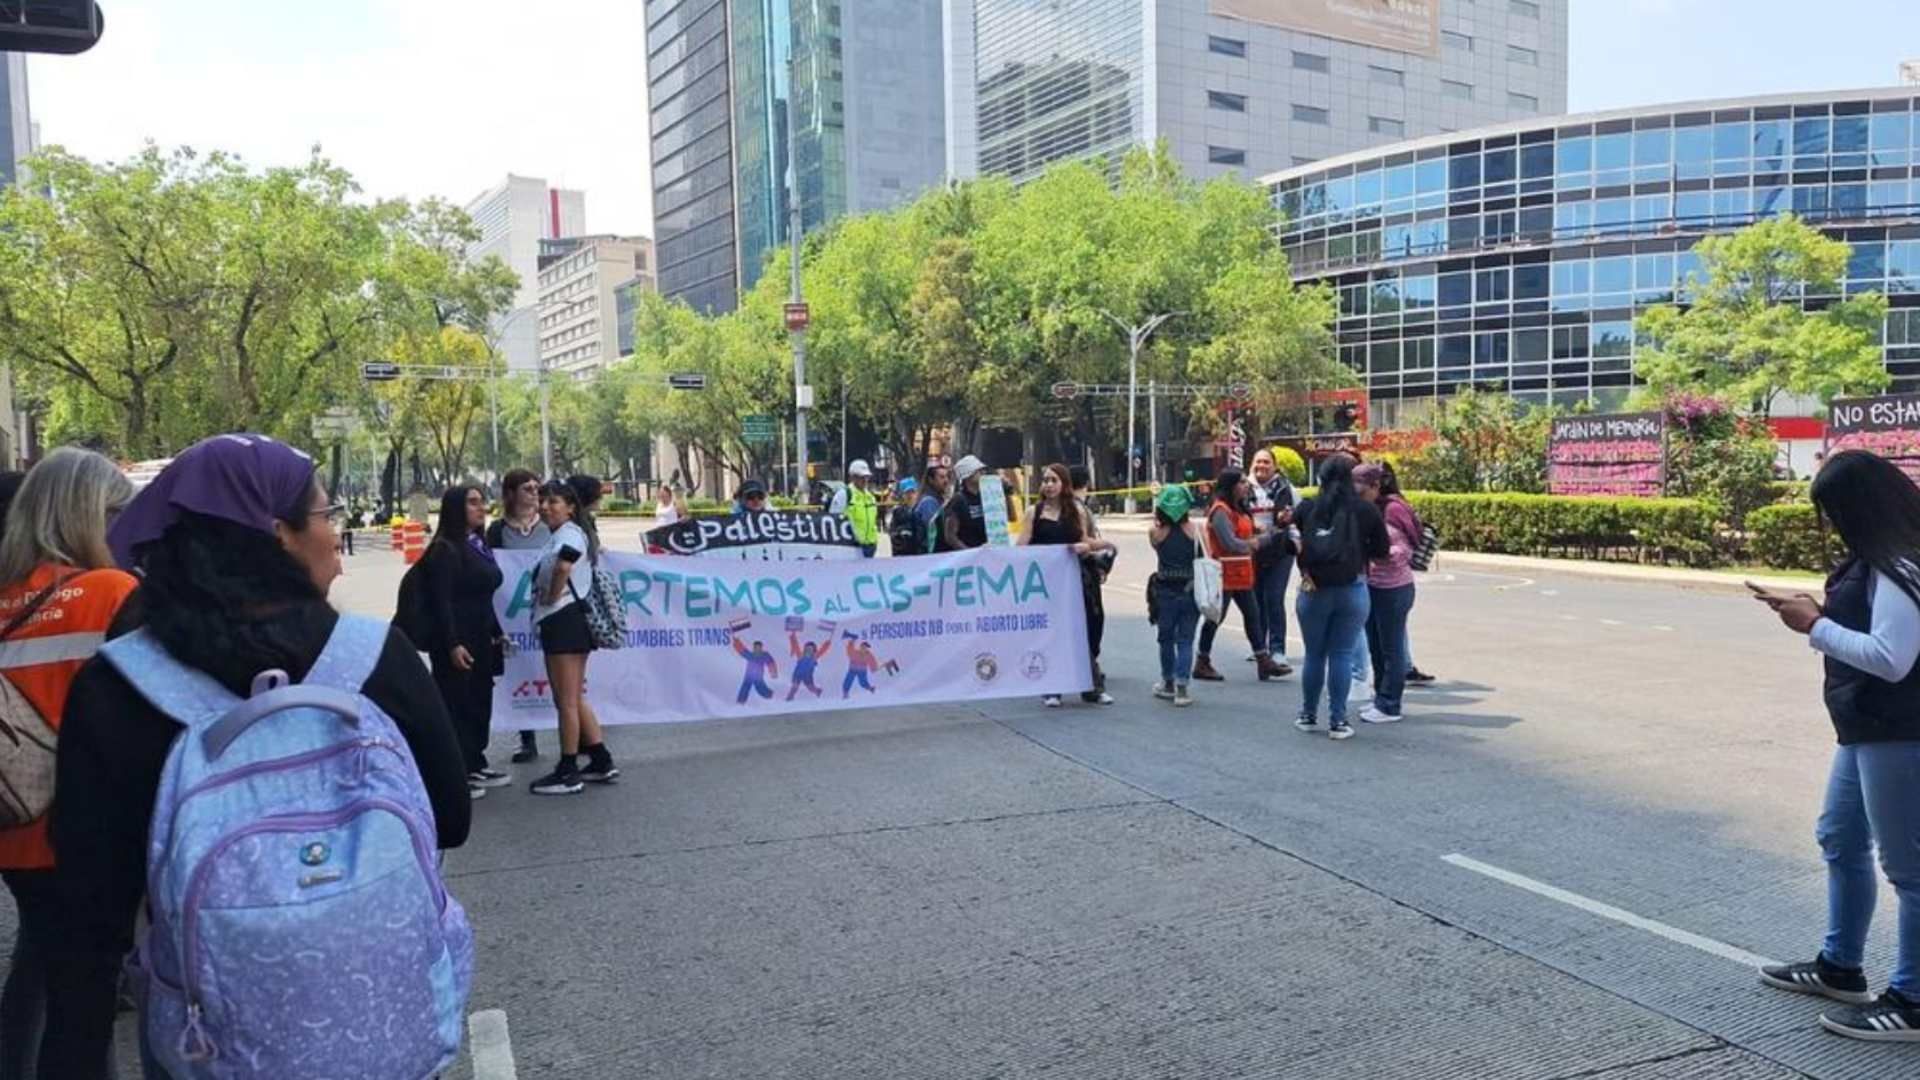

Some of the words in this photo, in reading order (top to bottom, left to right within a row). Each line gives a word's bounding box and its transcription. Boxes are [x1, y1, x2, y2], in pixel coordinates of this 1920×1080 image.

[505, 564, 812, 618] ARTEMOS
[823, 594, 850, 616] AL
[852, 560, 1049, 613] CIS-TEMA
[624, 628, 685, 648] OMBRES
[688, 627, 731, 646] TRANS
[870, 620, 927, 640] PERSONAS
[976, 613, 1019, 632] ABORTO
[1020, 612, 1049, 631] LIBRE
